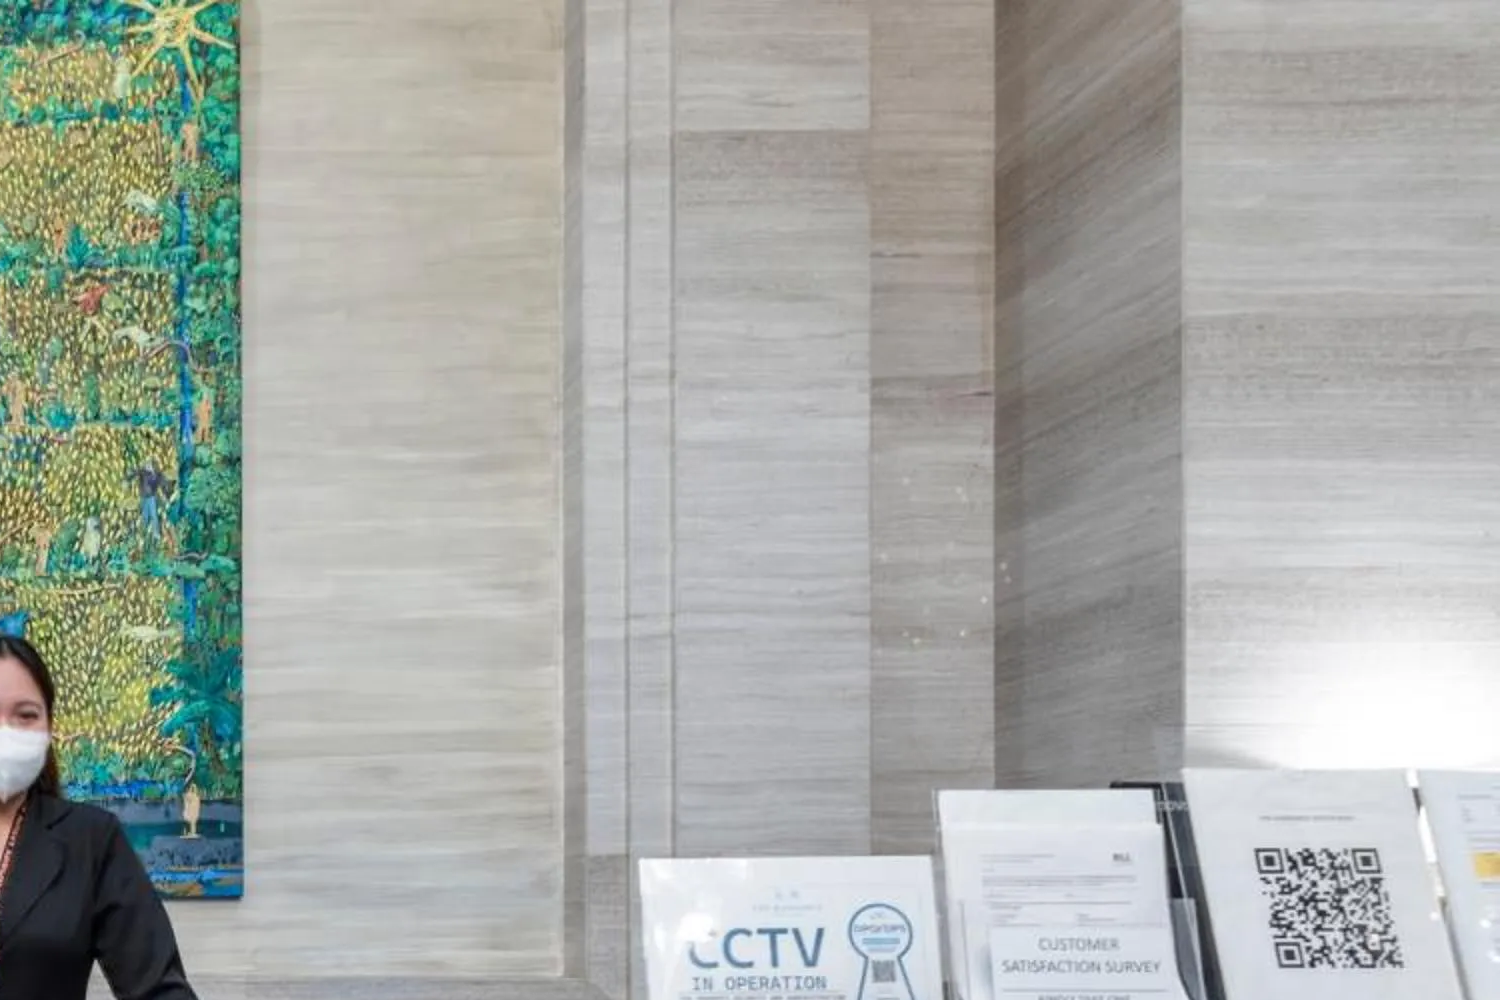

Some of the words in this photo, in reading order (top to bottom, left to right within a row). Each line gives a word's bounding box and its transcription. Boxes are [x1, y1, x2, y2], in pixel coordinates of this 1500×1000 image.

[687, 927, 825, 968] CCTV
[1038, 938, 1120, 951] CUSTOMER
[1001, 959, 1102, 974] SATISFACTION
[1104, 959, 1162, 974] SURVEY
[692, 977, 713, 991] IN
[724, 975, 828, 991] OPERATION
